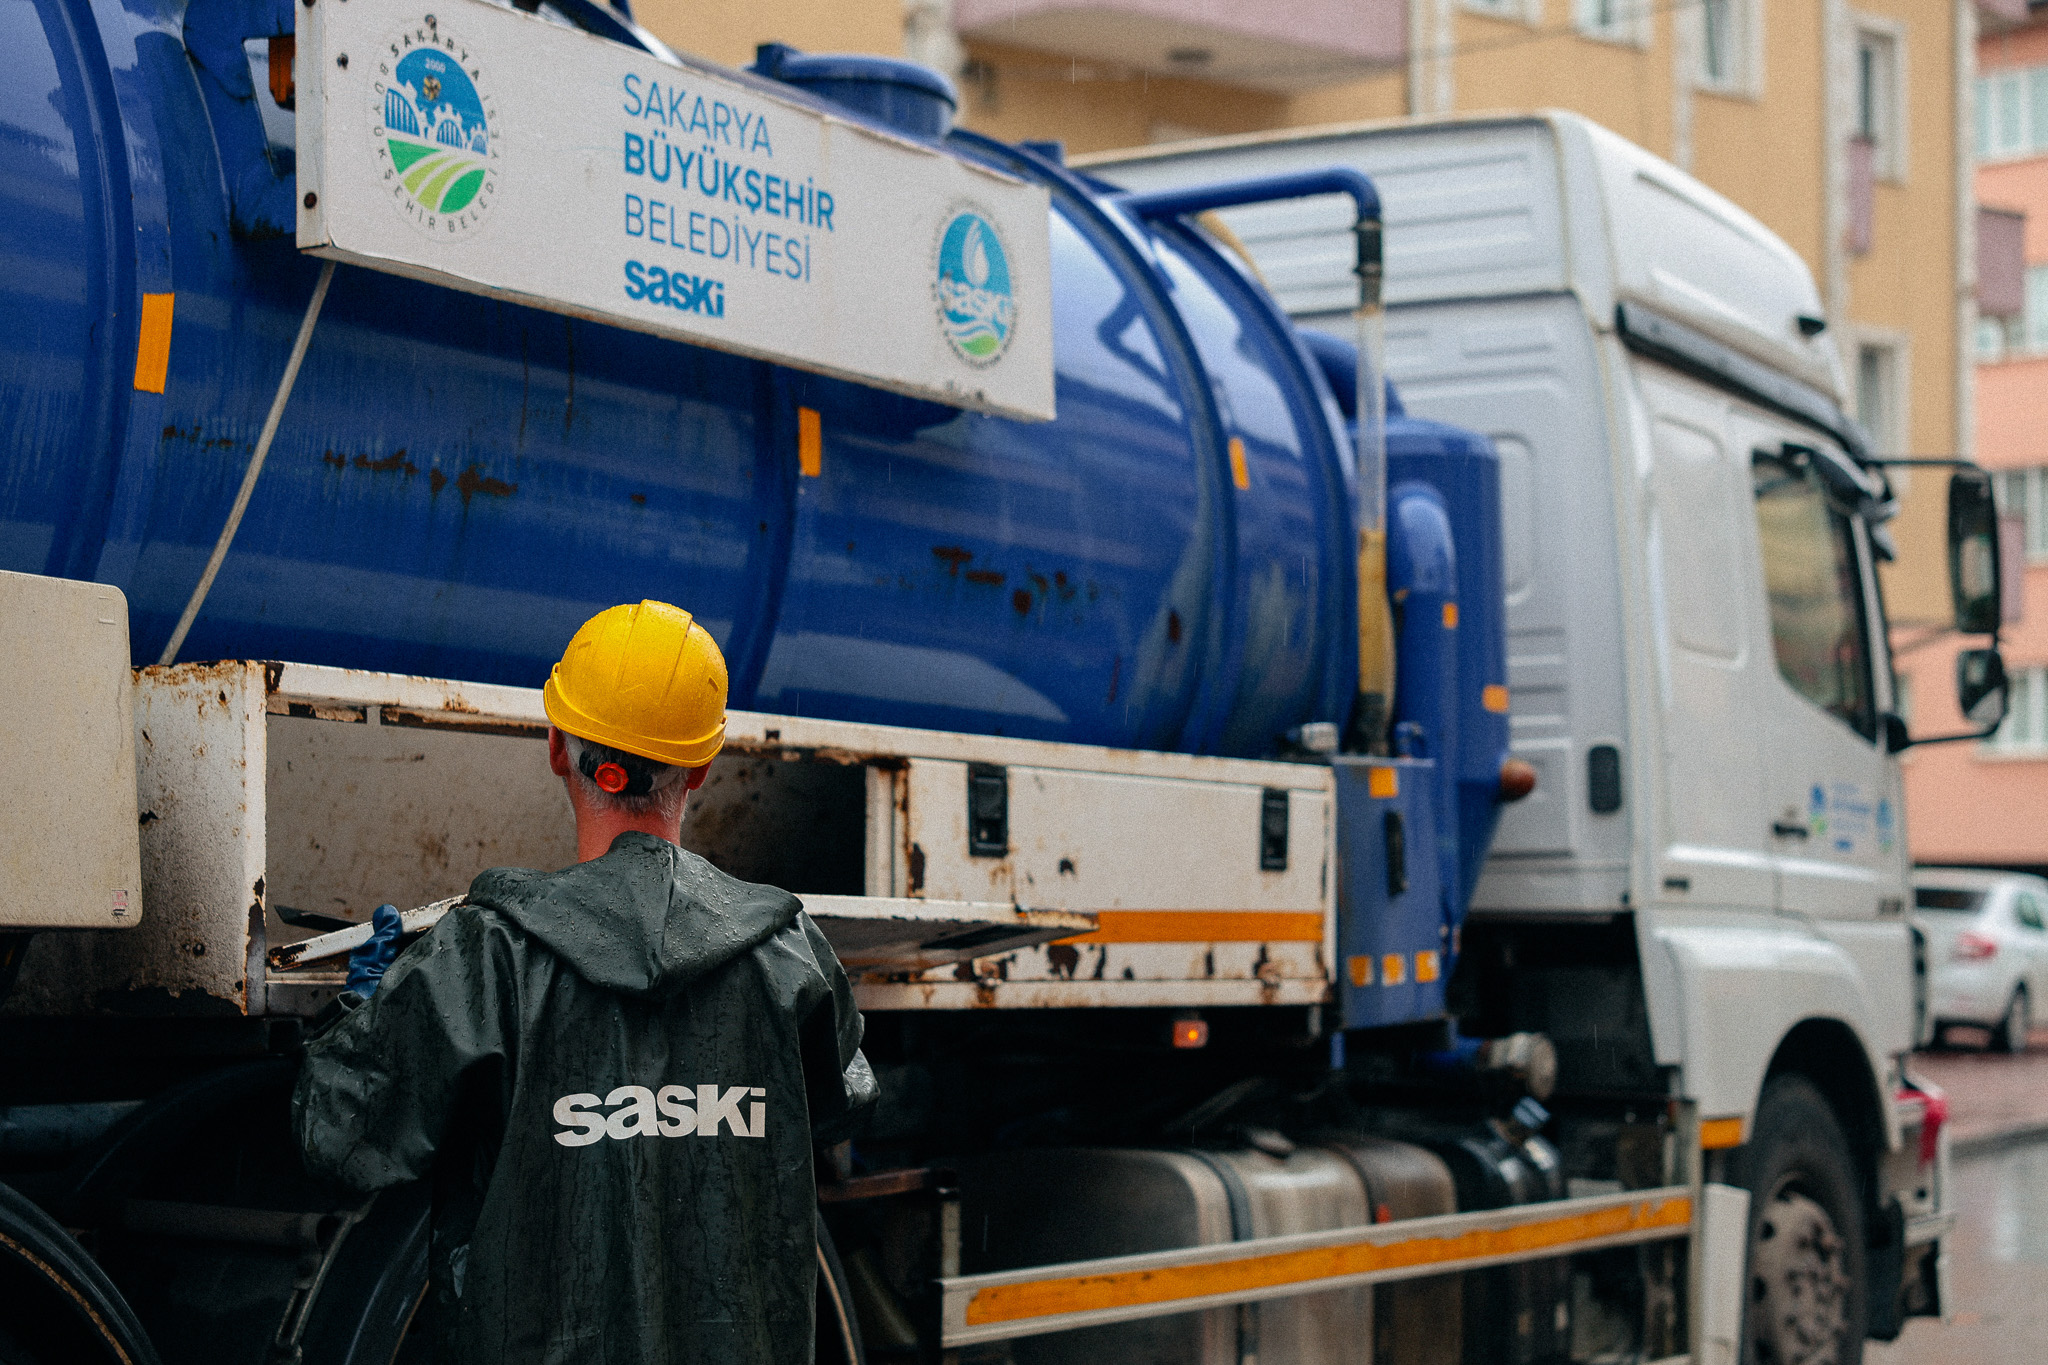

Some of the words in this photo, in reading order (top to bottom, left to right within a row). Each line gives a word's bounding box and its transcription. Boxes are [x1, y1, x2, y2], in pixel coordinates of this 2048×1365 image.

[391, 29, 480, 80] SAKARYA
[623, 73, 773, 158] SAKARYA
[624, 129, 835, 232] BÜYÜKŞEHİR
[625, 193, 811, 283] BELEDİYESİ
